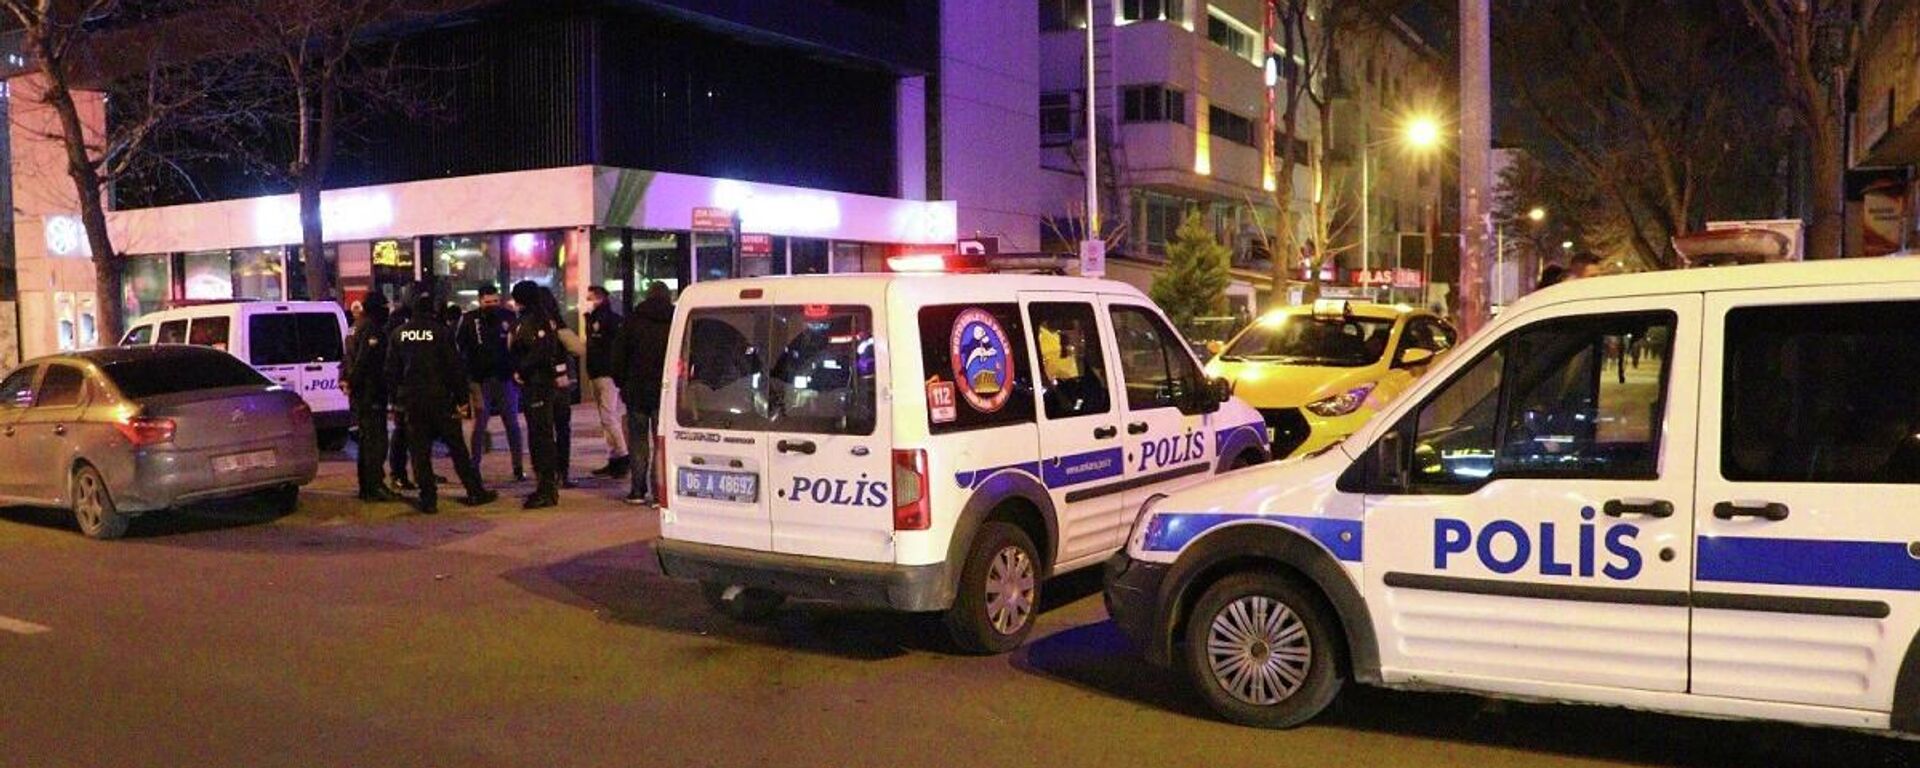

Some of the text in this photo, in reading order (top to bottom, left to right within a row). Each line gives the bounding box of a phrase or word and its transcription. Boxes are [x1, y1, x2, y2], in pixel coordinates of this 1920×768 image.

[311, 378, 340, 391] POL
[931, 386, 951, 406] 112
[1138, 427, 1204, 471] POLİS
[686, 473, 700, 490] 06
[788, 473, 888, 507] POLİS
[1434, 505, 1642, 580] POLİS
